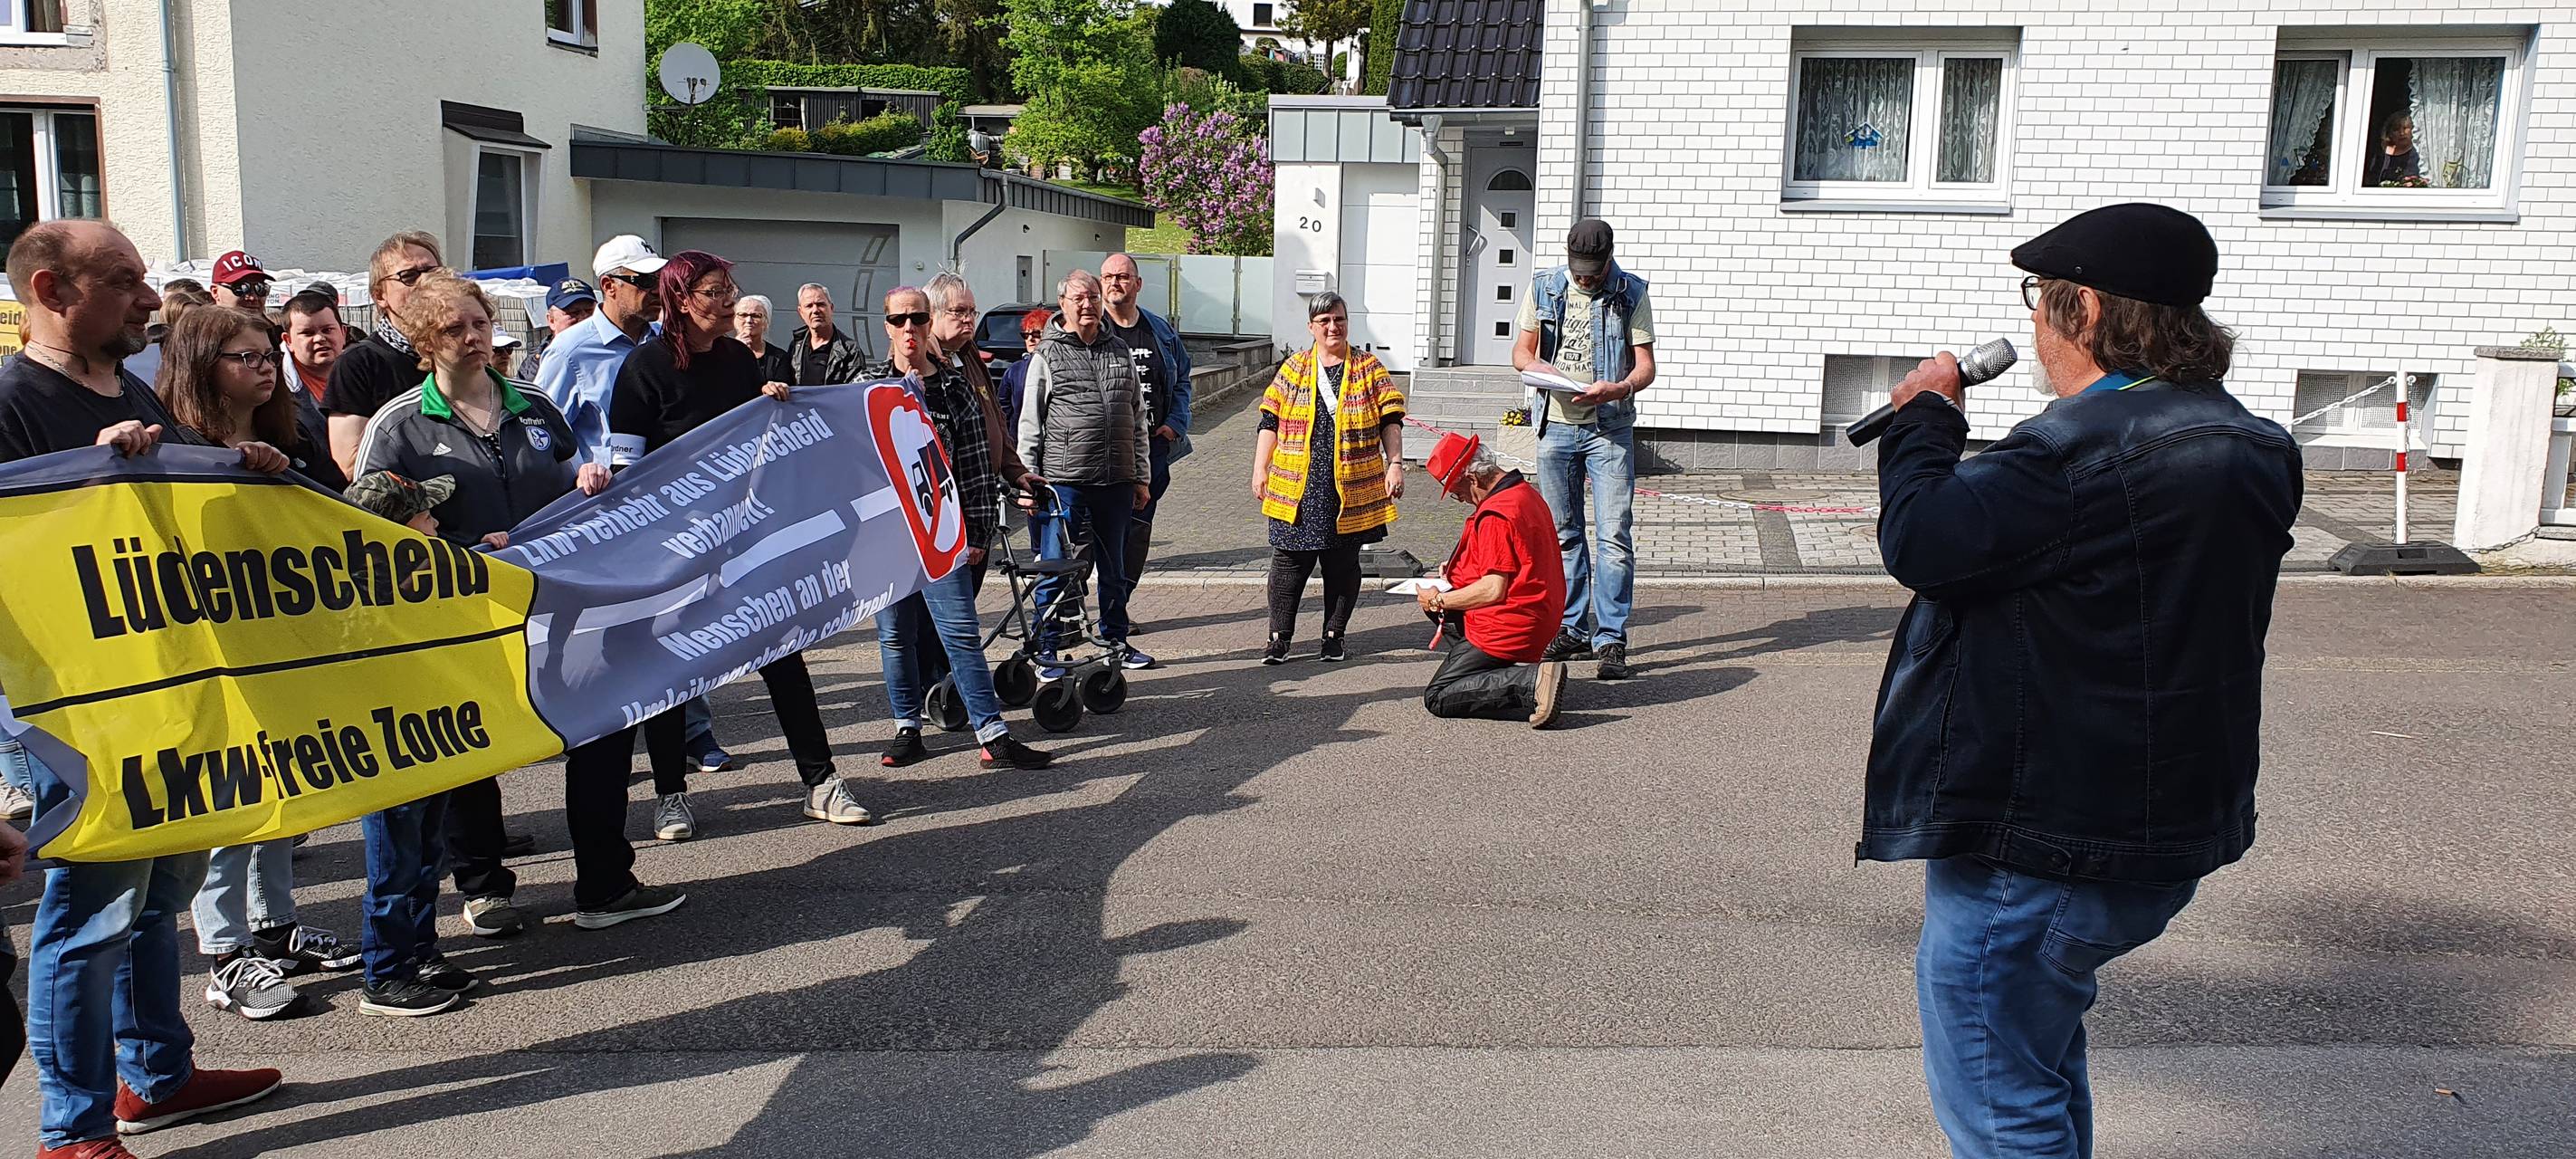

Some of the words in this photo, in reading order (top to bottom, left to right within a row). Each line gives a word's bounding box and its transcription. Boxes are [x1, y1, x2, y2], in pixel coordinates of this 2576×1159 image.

[1300, 216, 1321, 233] 20
[659, 472, 717, 507] aus
[696, 408, 834, 482] Lüdenscheid
[662, 488, 775, 559] verbannen!
[72, 530, 489, 639] Lüdenscheid
[657, 586, 797, 661] Menschen
[795, 573, 823, 610] an
[822, 559, 852, 598] der
[370, 700, 491, 771] Zone
